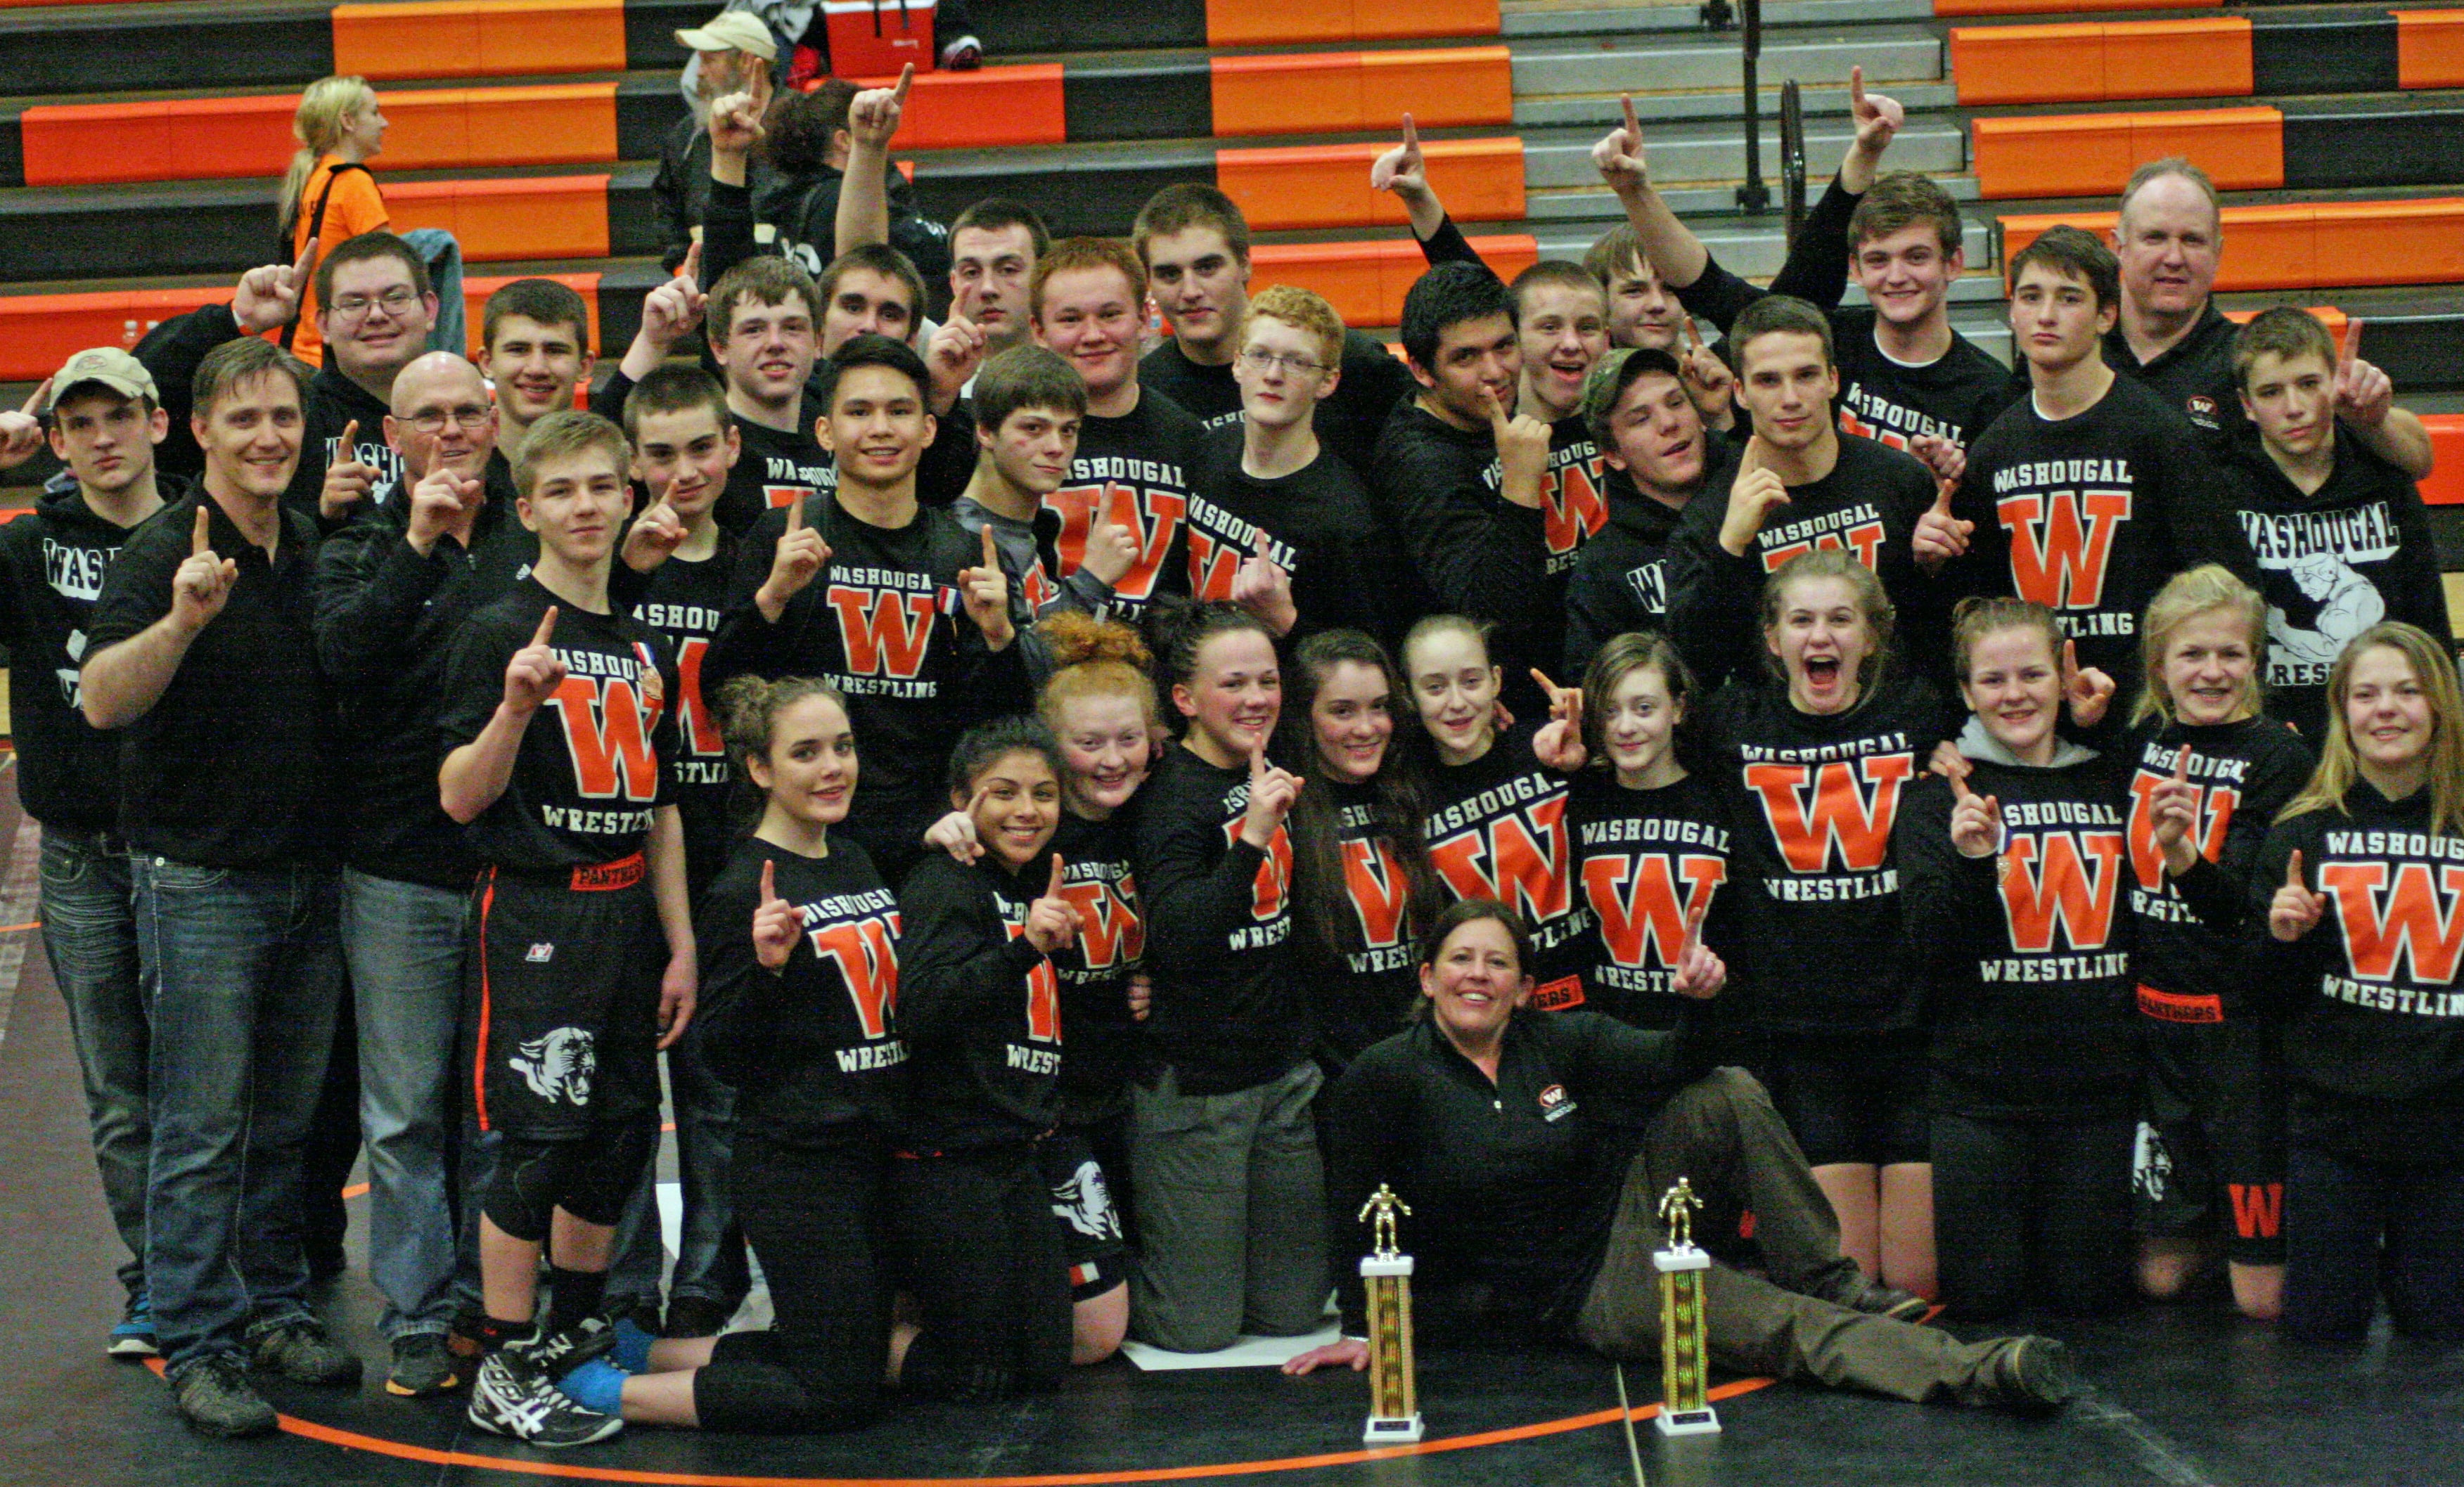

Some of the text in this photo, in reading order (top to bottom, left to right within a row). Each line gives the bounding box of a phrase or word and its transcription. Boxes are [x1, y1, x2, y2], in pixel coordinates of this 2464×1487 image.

[1758, 503, 1880, 548] WASHOUGAL
[1994, 459, 2133, 492] WASHOUGAL
[1189, 492, 1297, 572] WASHOUAL
[1996, 490, 2133, 611] W
[826, 584, 934, 679] W
[543, 673, 665, 803] W
[1581, 818, 1731, 854] WASHOUGAL
[1743, 752, 1914, 874] W
[1580, 853, 1728, 969] W
[1997, 830, 2124, 953] W
[2318, 861, 2464, 984] W
[2228, 1183, 2284, 1239] W
